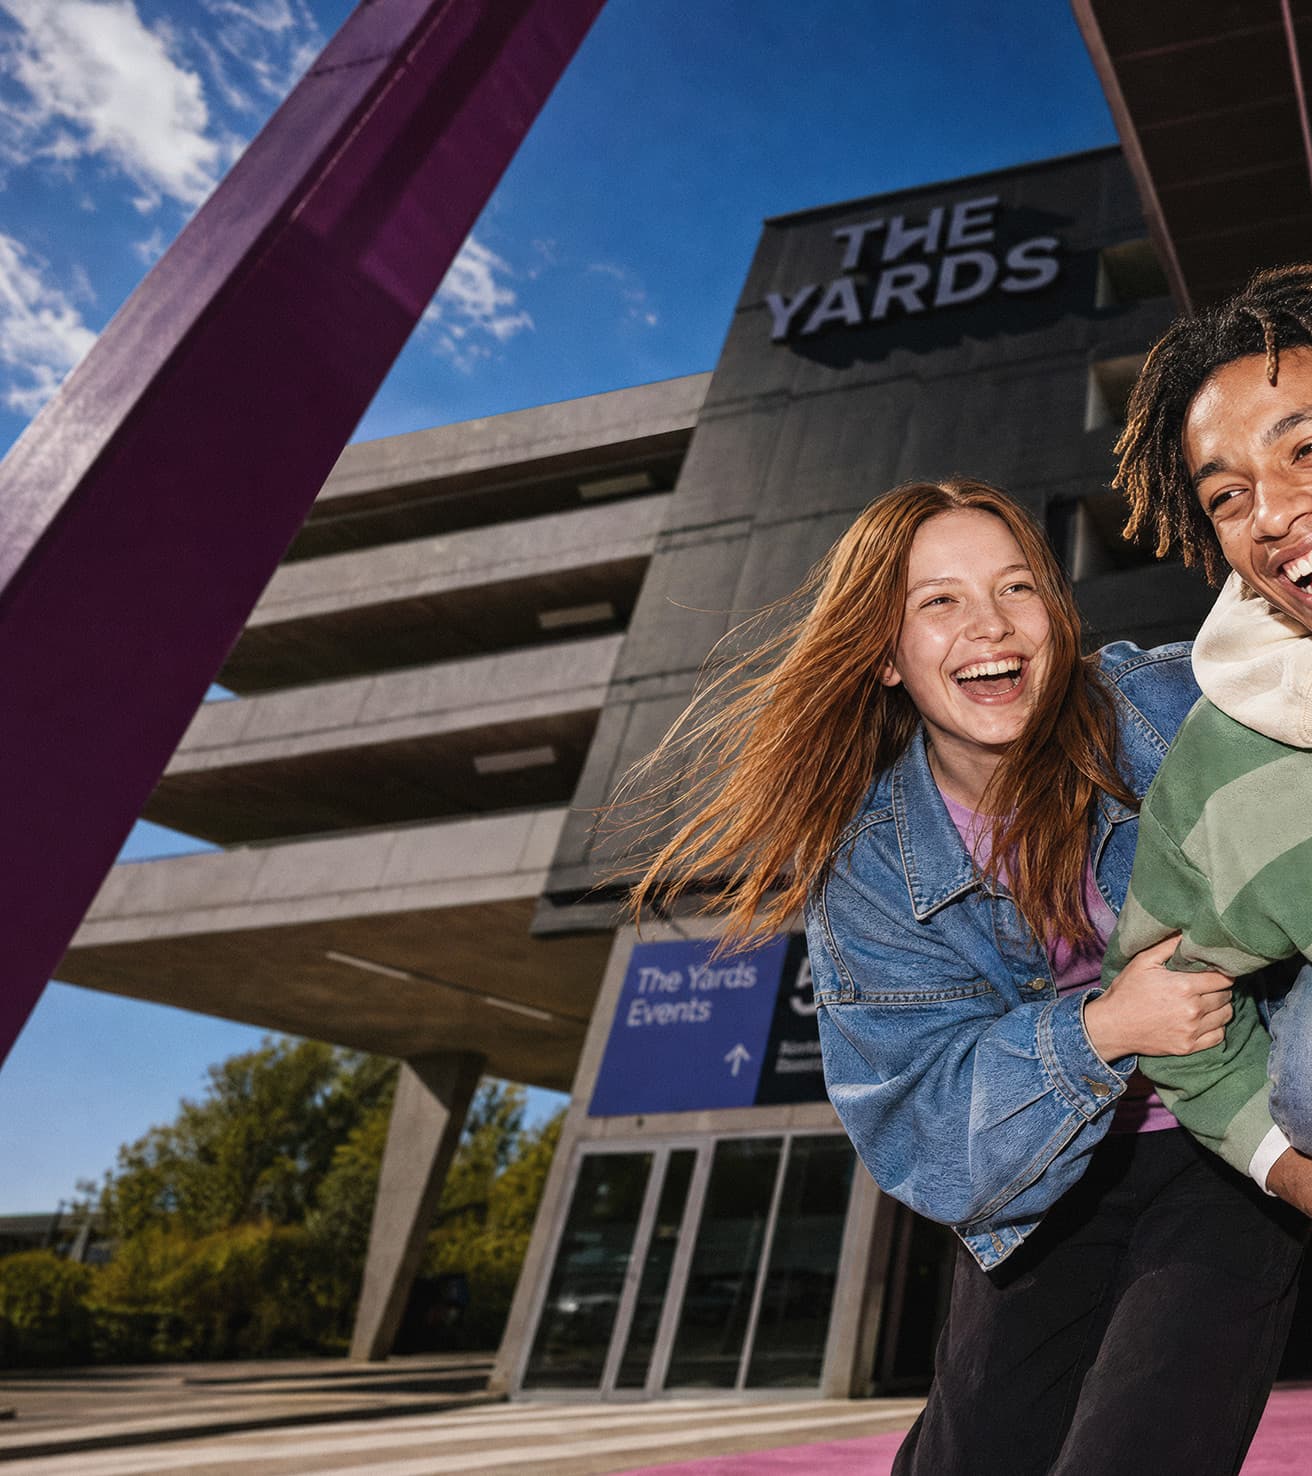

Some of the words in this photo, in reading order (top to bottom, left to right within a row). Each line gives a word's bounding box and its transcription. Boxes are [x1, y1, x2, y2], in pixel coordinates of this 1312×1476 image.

[832, 196, 998, 270] THE
[766, 236, 1060, 341] YARDS
[638, 966, 683, 993] The
[687, 961, 758, 991] Yards
[626, 998, 712, 1027] Events
